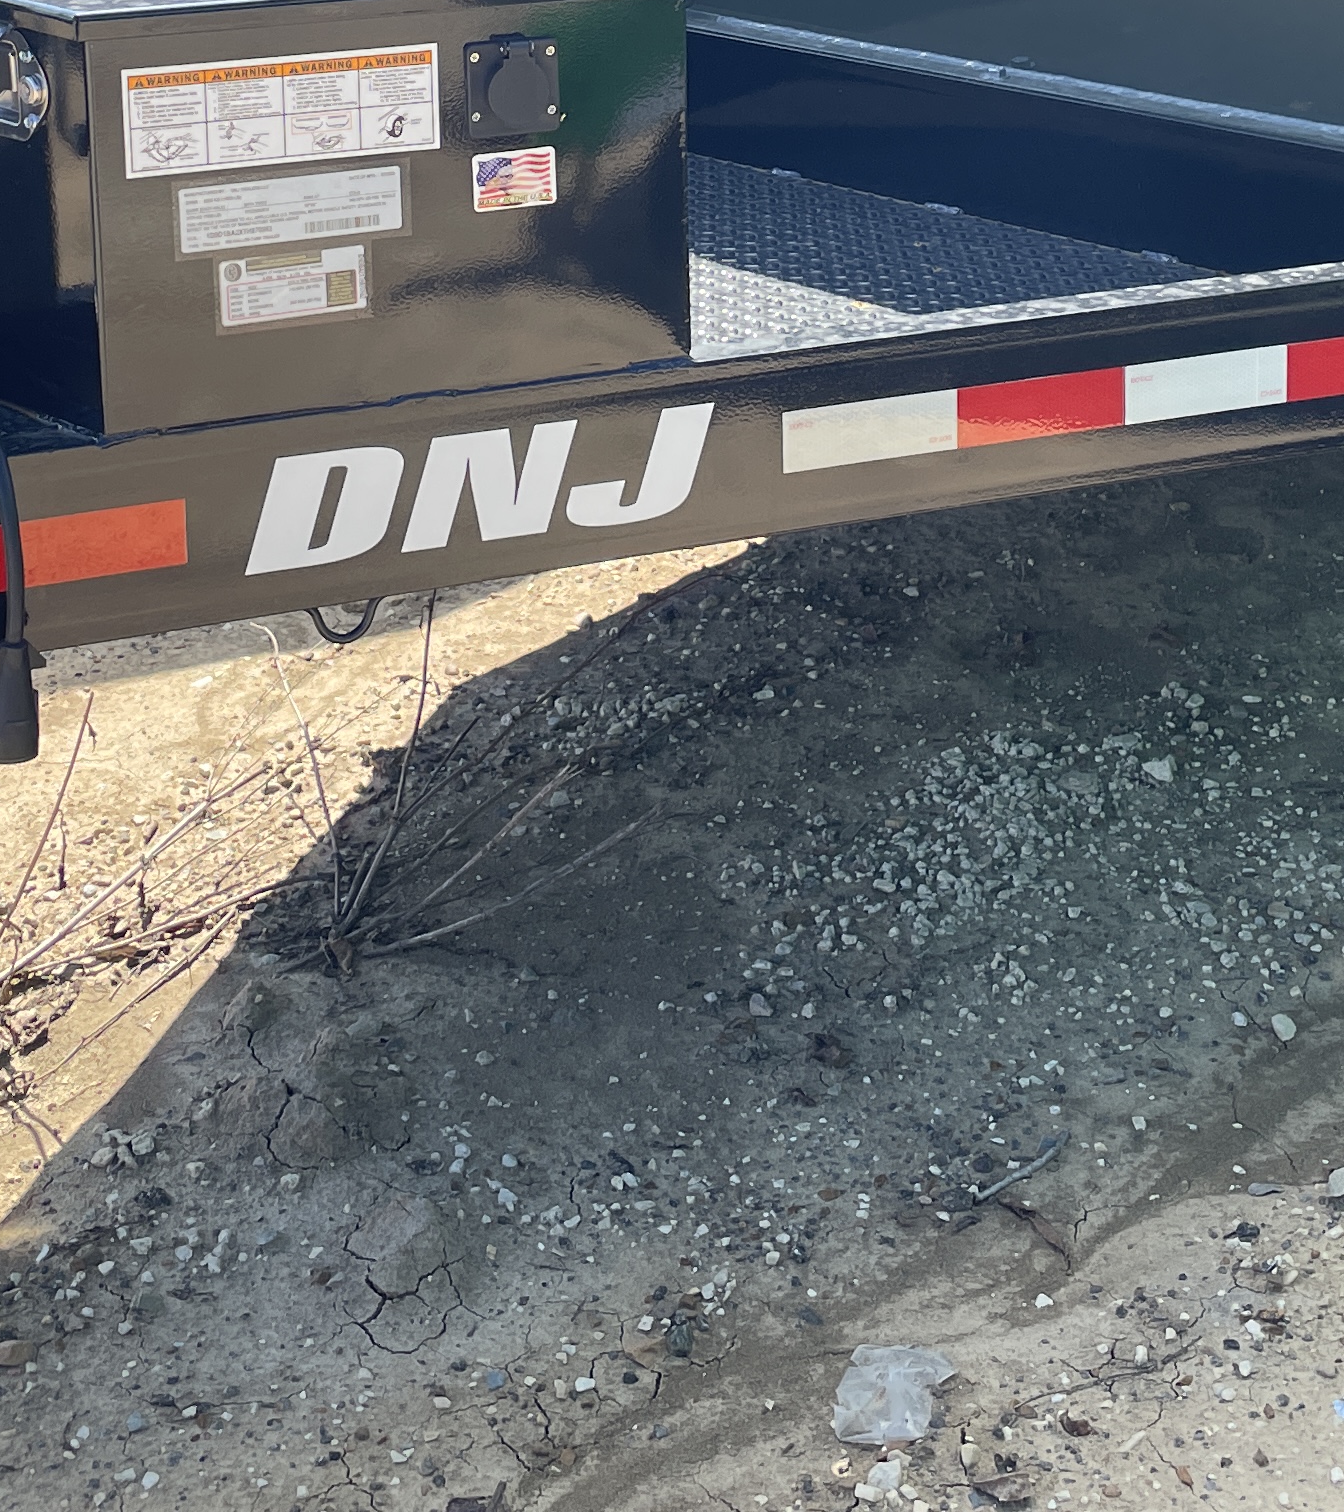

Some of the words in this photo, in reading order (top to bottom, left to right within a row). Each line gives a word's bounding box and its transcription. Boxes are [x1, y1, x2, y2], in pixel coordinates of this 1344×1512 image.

[300, 59, 353, 73] WARNING
[375, 52, 427, 67] WARNING
[145, 72, 201, 86] WARNING
[223, 66, 277, 80] WARNING
[244, 402, 716, 577] DNJ
